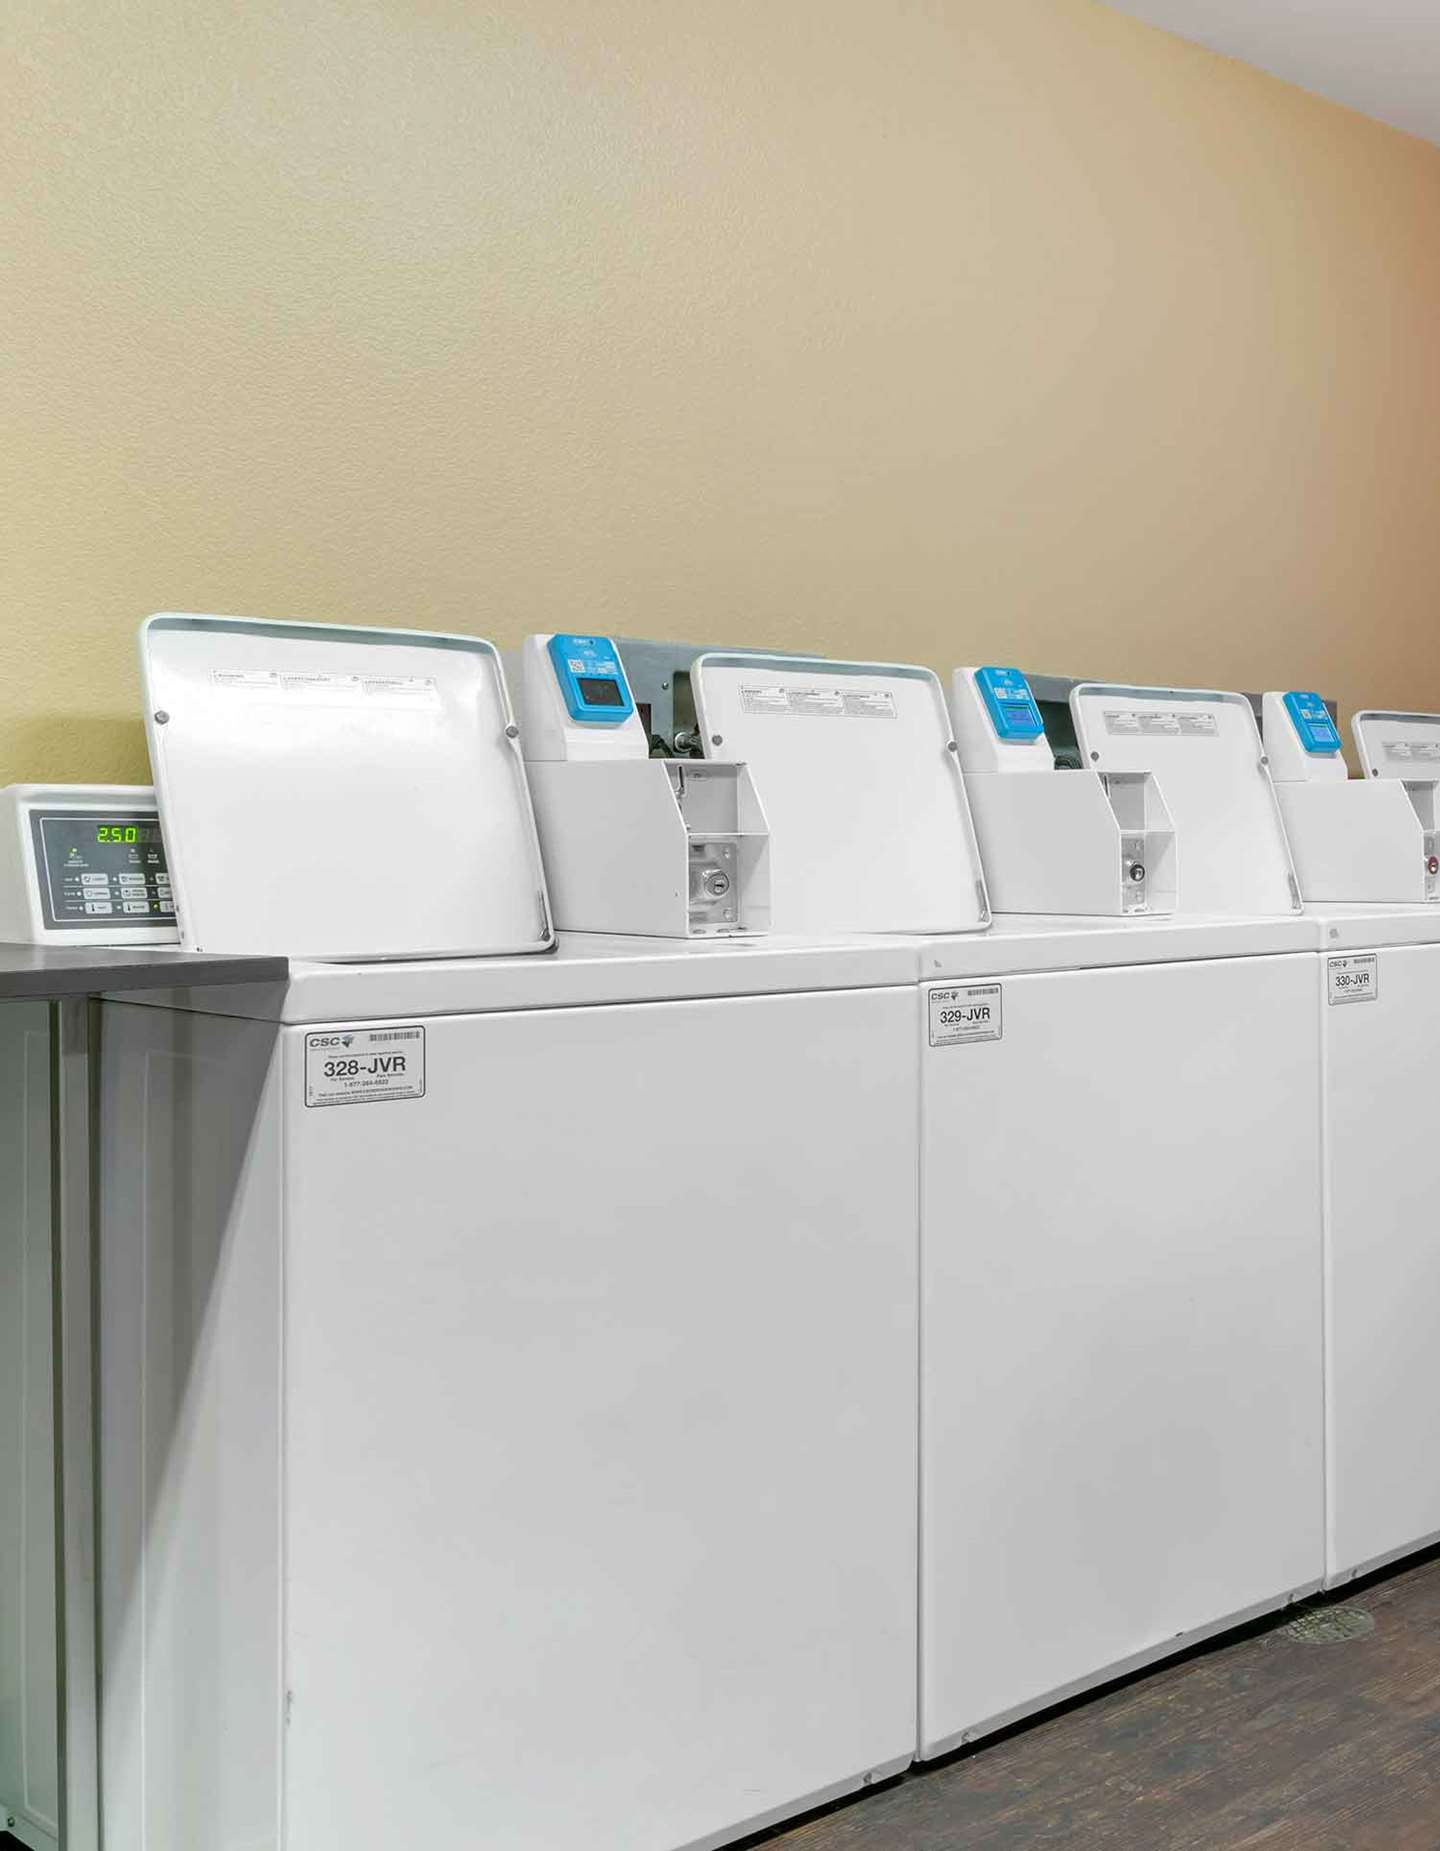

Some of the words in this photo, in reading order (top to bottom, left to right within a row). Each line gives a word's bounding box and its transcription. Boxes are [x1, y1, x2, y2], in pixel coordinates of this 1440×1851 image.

[97, 827, 137, 843] 2.50
[1335, 973, 1370, 986] 330-JVR
[931, 992, 950, 1000] CSC
[940, 1007, 990, 1024] 329-JVR
[309, 1036, 341, 1048] CSC
[323, 1056, 406, 1077] 328-JVR
